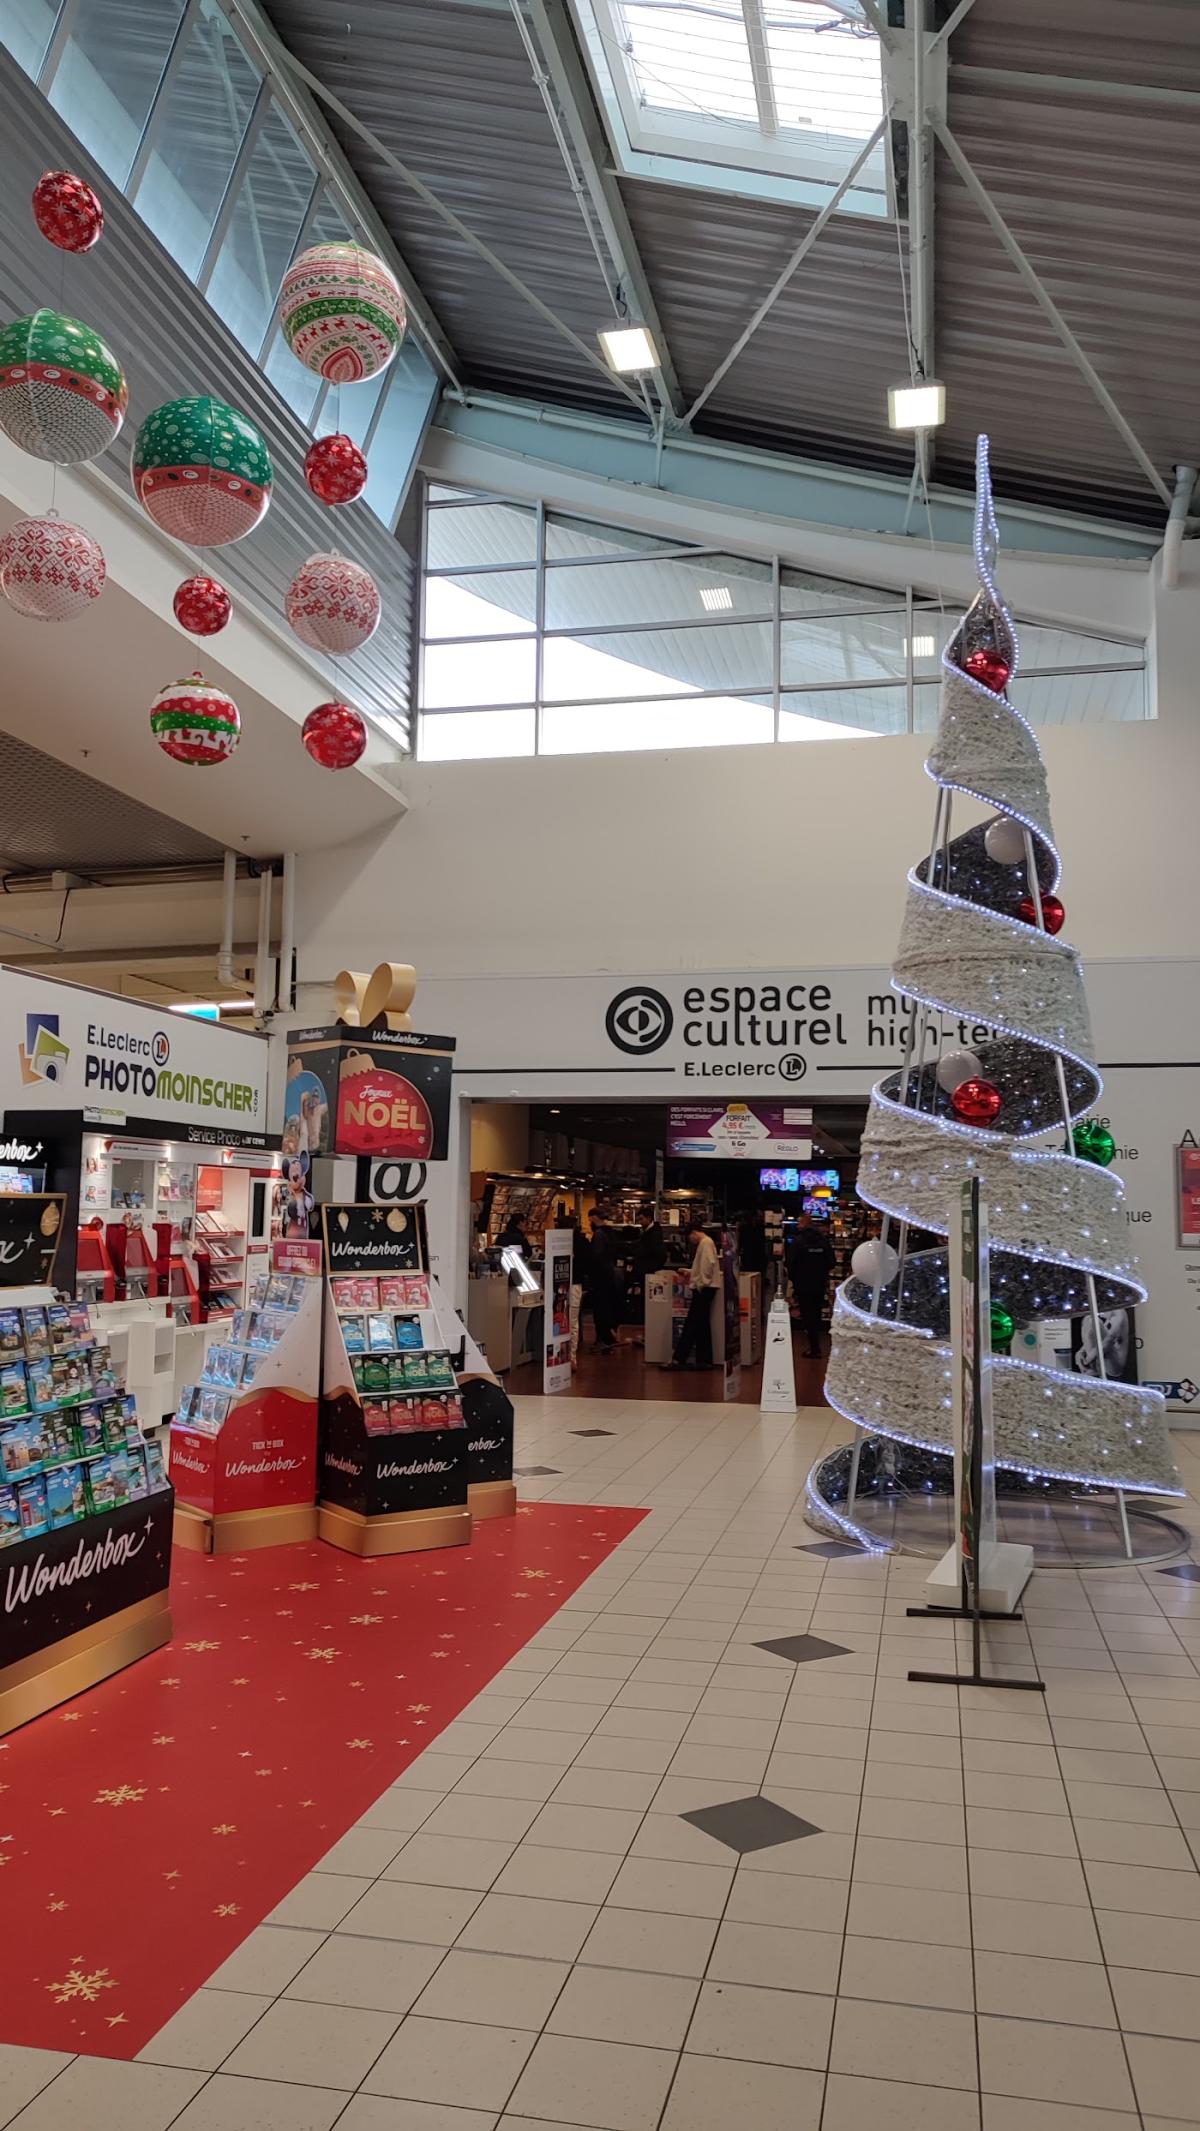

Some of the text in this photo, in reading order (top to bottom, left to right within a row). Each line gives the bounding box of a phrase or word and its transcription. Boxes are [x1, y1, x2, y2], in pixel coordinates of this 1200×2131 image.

[683, 985, 831, 1016] espace
[87, 1024, 151, 1056] E.Leclerc
[372, 1030, 424, 1045] Wonderbox
[683, 1013, 847, 1046] culturel
[868, 1018, 998, 1053] high-te
[684, 1061, 776, 1077] E.Leclerc
[359, 1085, 393, 1102] Joyeux
[344, 1099, 426, 1130] NOËL
[188, 1127, 216, 1144] Service
[332, 1240, 410, 1257] Wonderbox
[467, 1437, 501, 1451] erbox
[173, 1450, 208, 1474] Wonderbox
[226, 1456, 302, 1478] Wonderbox
[325, 1452, 360, 1476] Wonderbox
[376, 1458, 453, 1479] Wonderbox
[5, 1527, 145, 1613] Wonderbox
